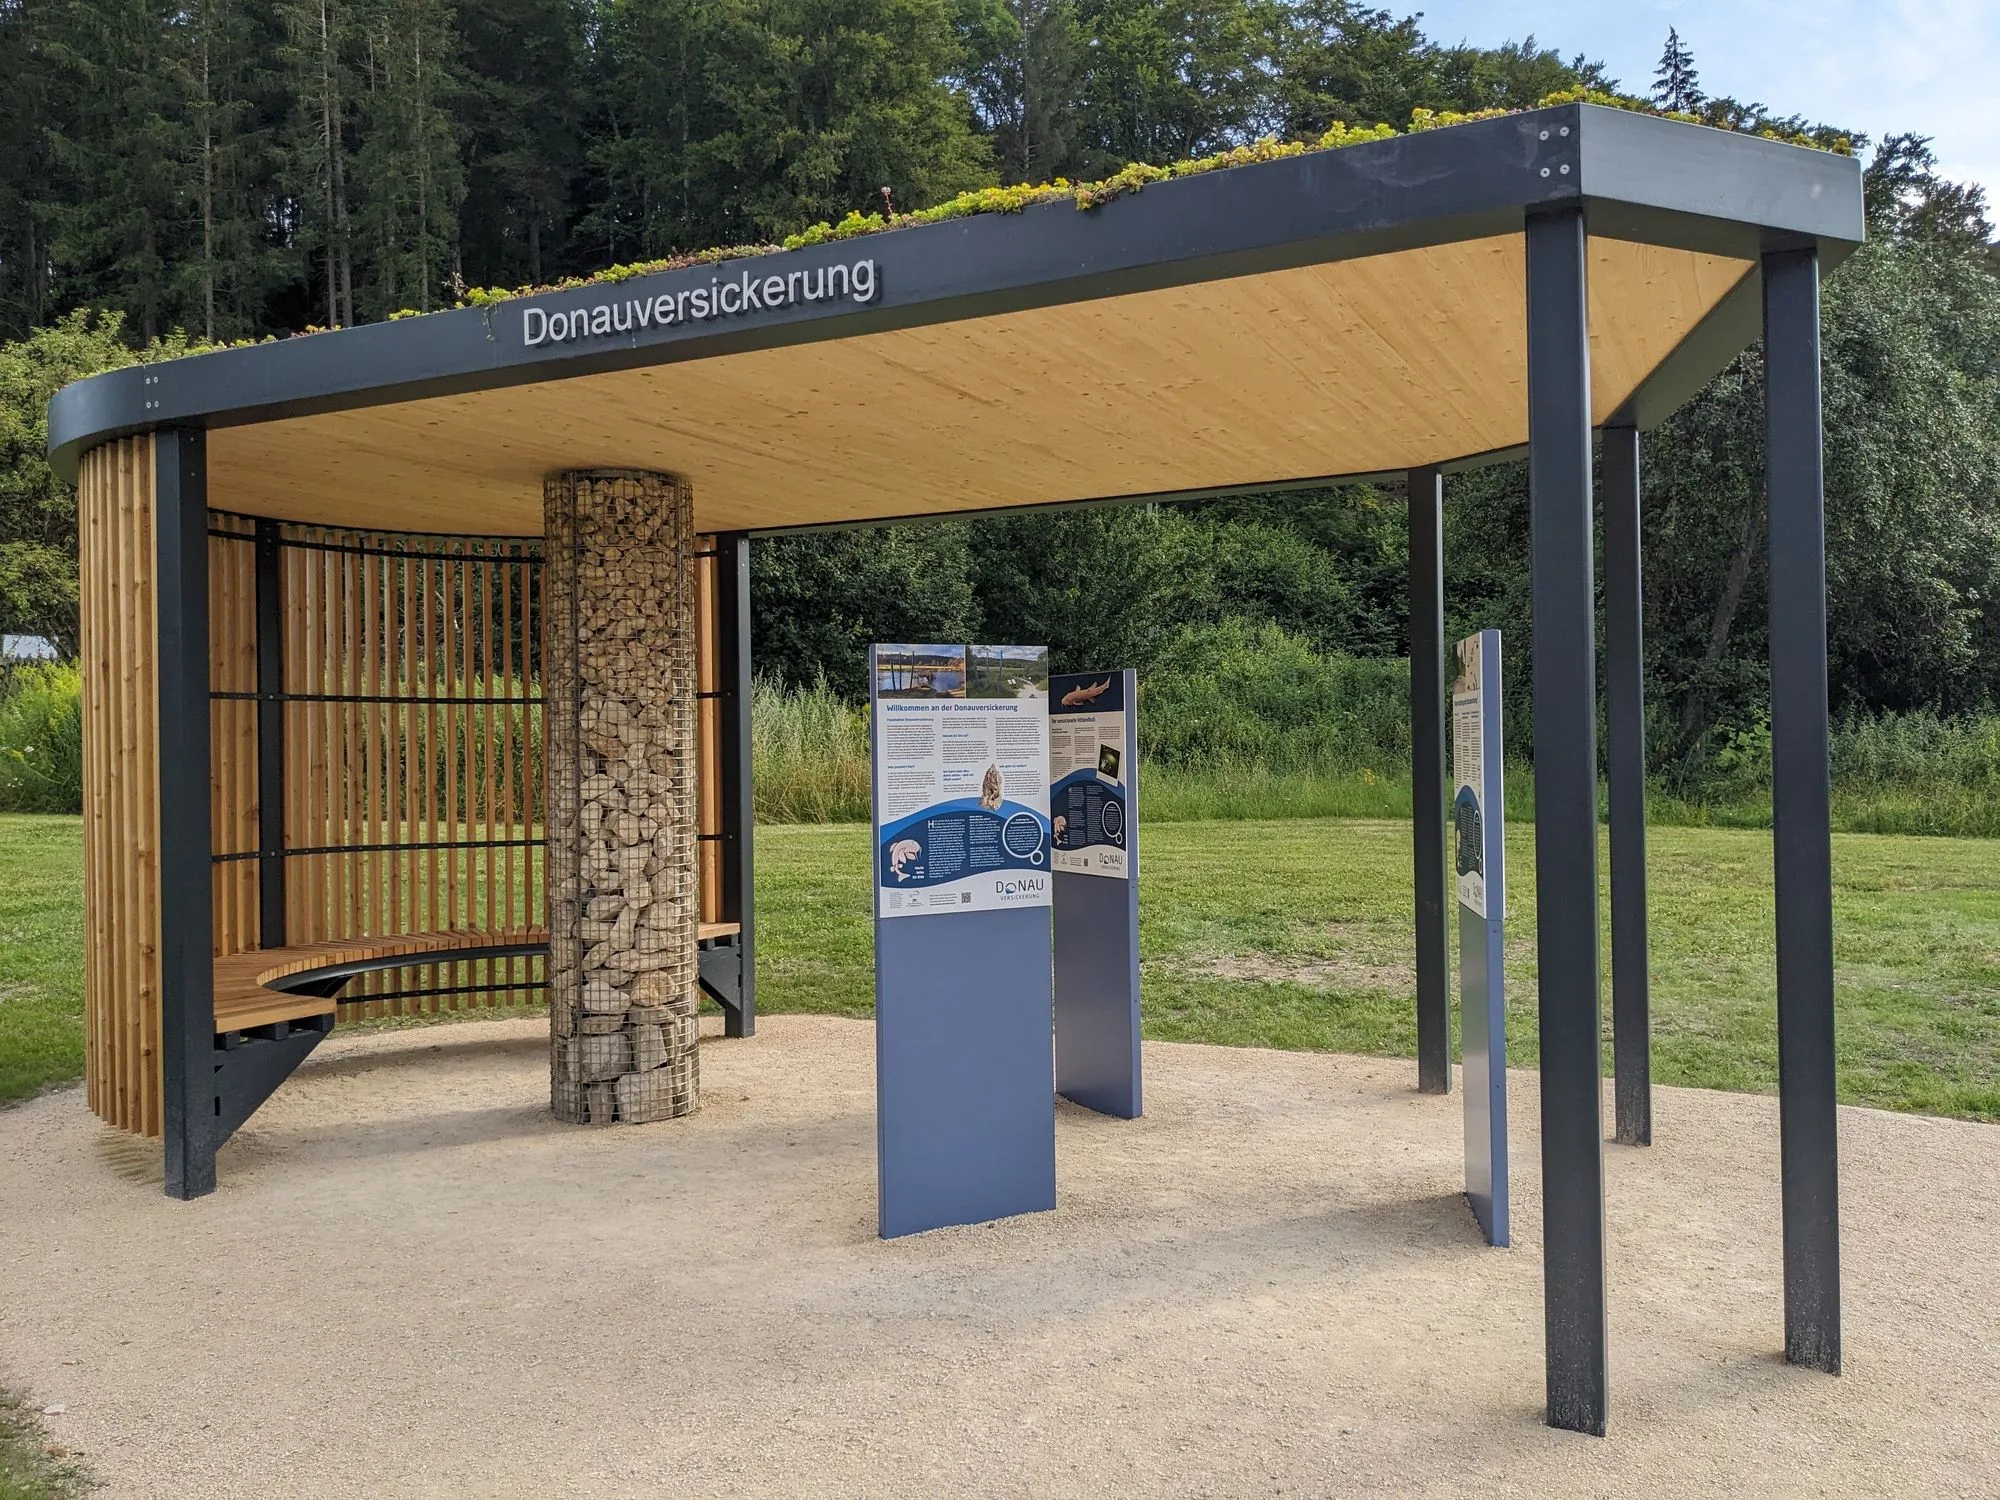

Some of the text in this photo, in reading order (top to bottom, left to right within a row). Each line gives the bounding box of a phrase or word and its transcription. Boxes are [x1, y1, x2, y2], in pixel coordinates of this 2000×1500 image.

[523, 258, 876, 347] Donauversickerung
[886, 704, 930, 712] Willkommen
[941, 704, 953, 712] der
[954, 703, 1018, 713] Donauversickerung
[995, 878, 1044, 895] DONAU
[1000, 892, 1040, 901] VERSICKERUNG
